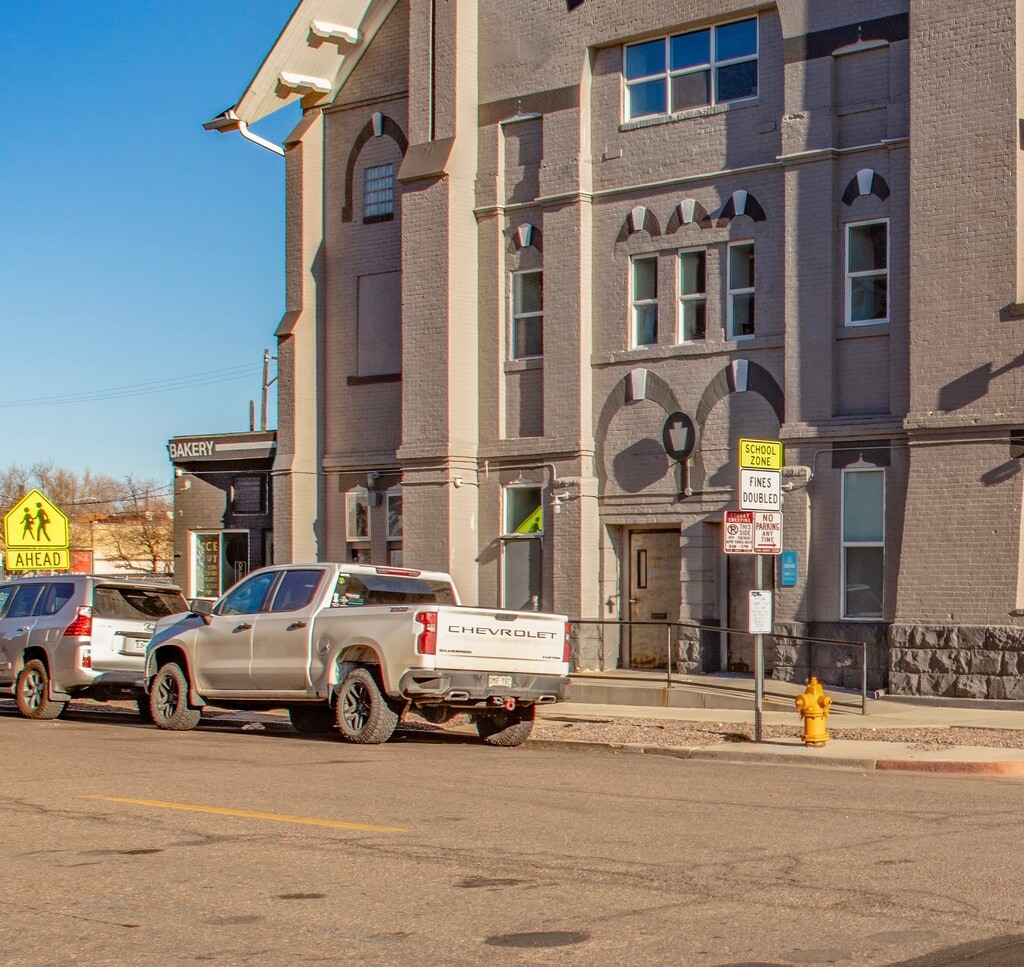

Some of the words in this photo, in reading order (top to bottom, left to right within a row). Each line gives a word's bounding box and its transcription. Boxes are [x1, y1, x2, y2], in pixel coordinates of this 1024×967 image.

[169, 440, 214, 458] BAKERY
[745, 444, 776, 456] SCHOOL
[750, 456, 771, 466] ZONE
[749, 477, 772, 488] FINES
[743, 492, 778, 504] DOUBLED
[762, 514, 774, 522] NO
[15, 552, 61, 567] AHEAD
[448, 625, 557, 639] CHEVROLET
